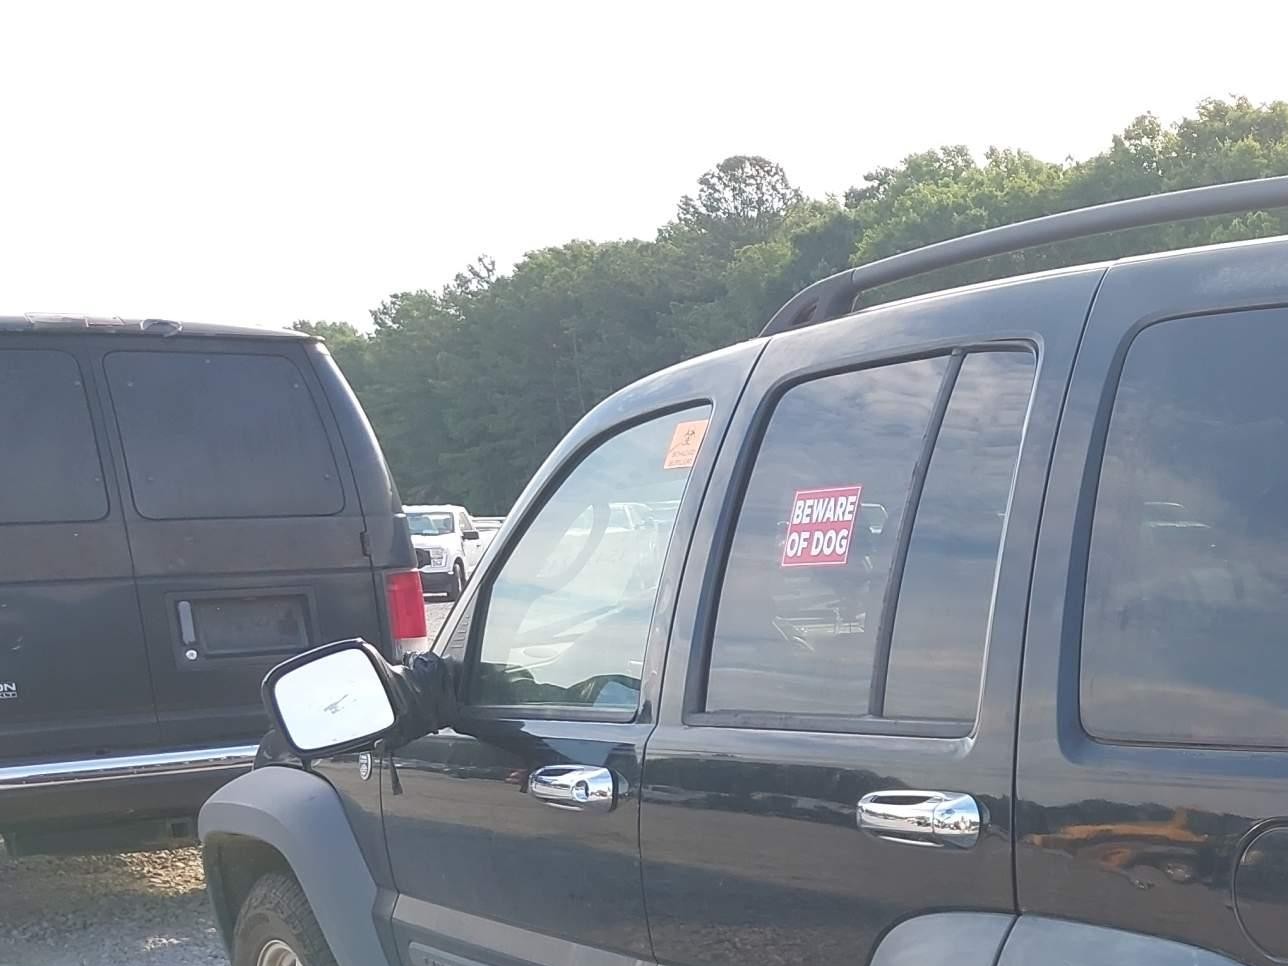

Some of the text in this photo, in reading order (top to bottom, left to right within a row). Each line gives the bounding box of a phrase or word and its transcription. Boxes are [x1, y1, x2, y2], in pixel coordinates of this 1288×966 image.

[792, 495, 857, 525] BEWARE
[786, 528, 849, 558] OF DOG
